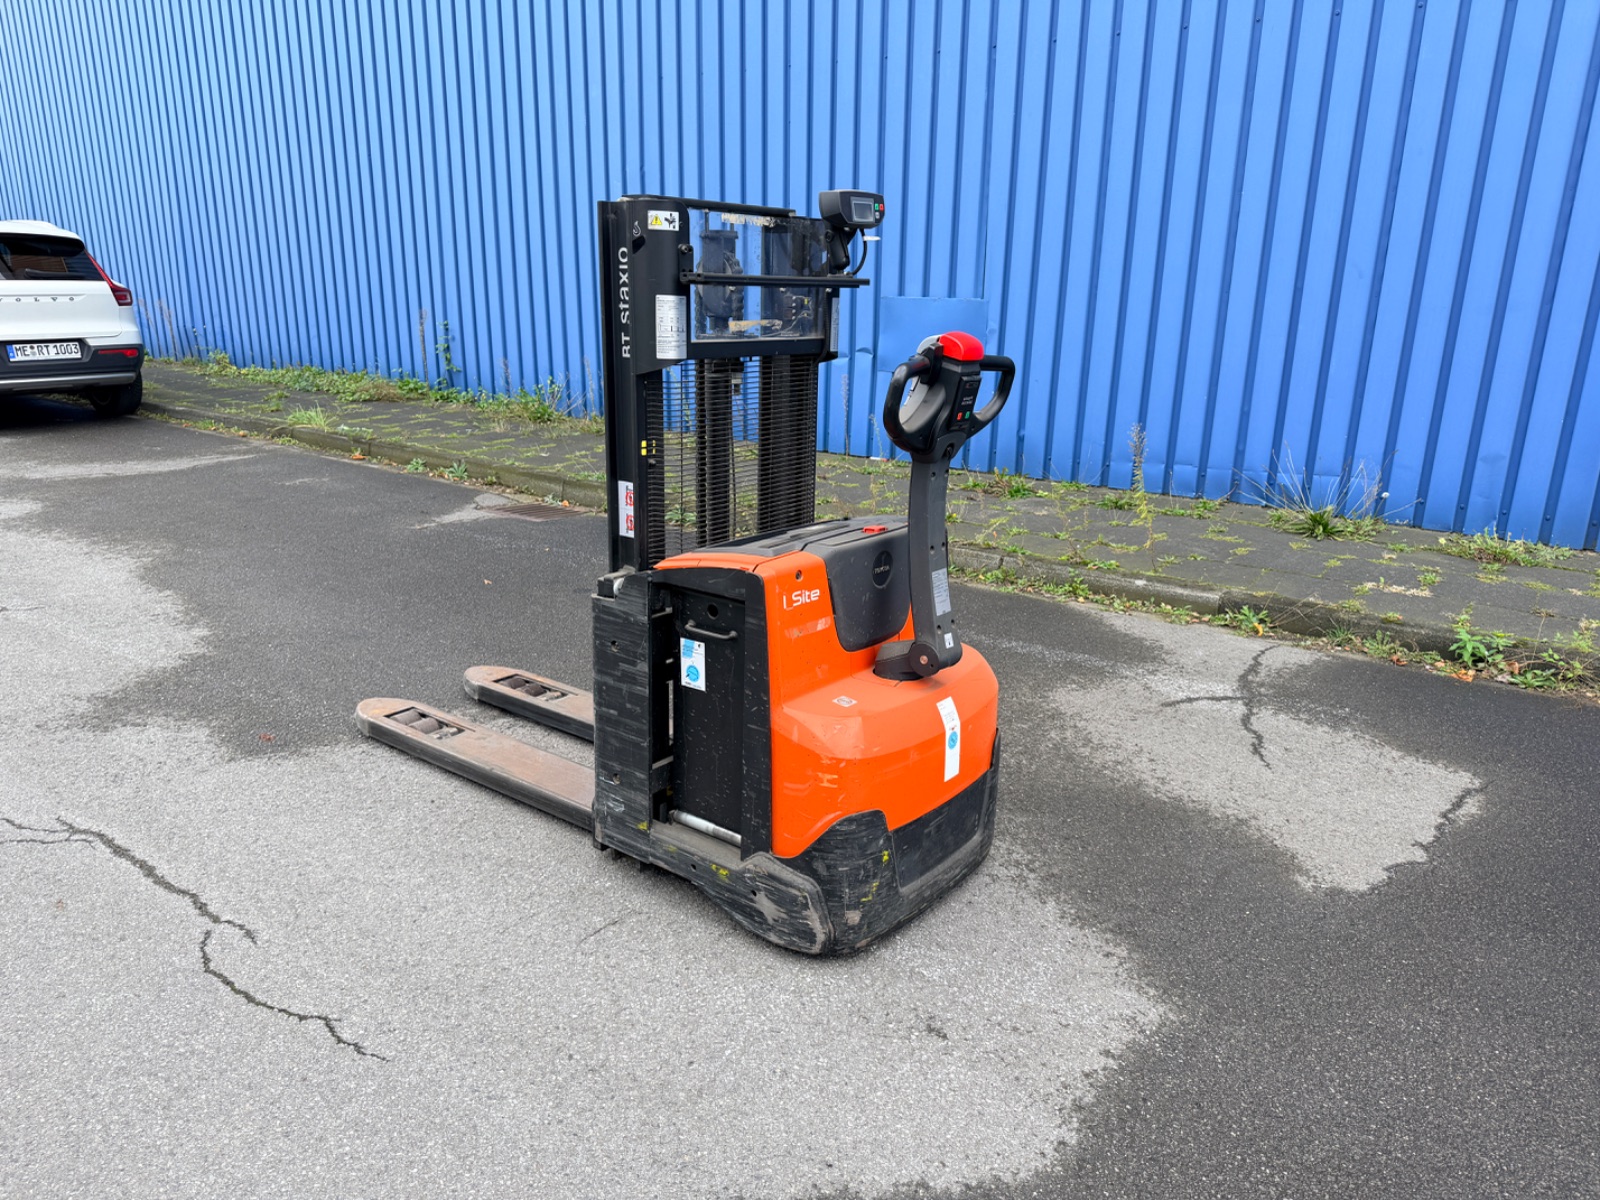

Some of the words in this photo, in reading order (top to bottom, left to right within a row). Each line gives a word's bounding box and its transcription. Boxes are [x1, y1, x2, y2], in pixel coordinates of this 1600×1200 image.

[14, 345, 30, 357] ME
[37, 344, 50, 356] RT
[53, 343, 79, 355] 1003
